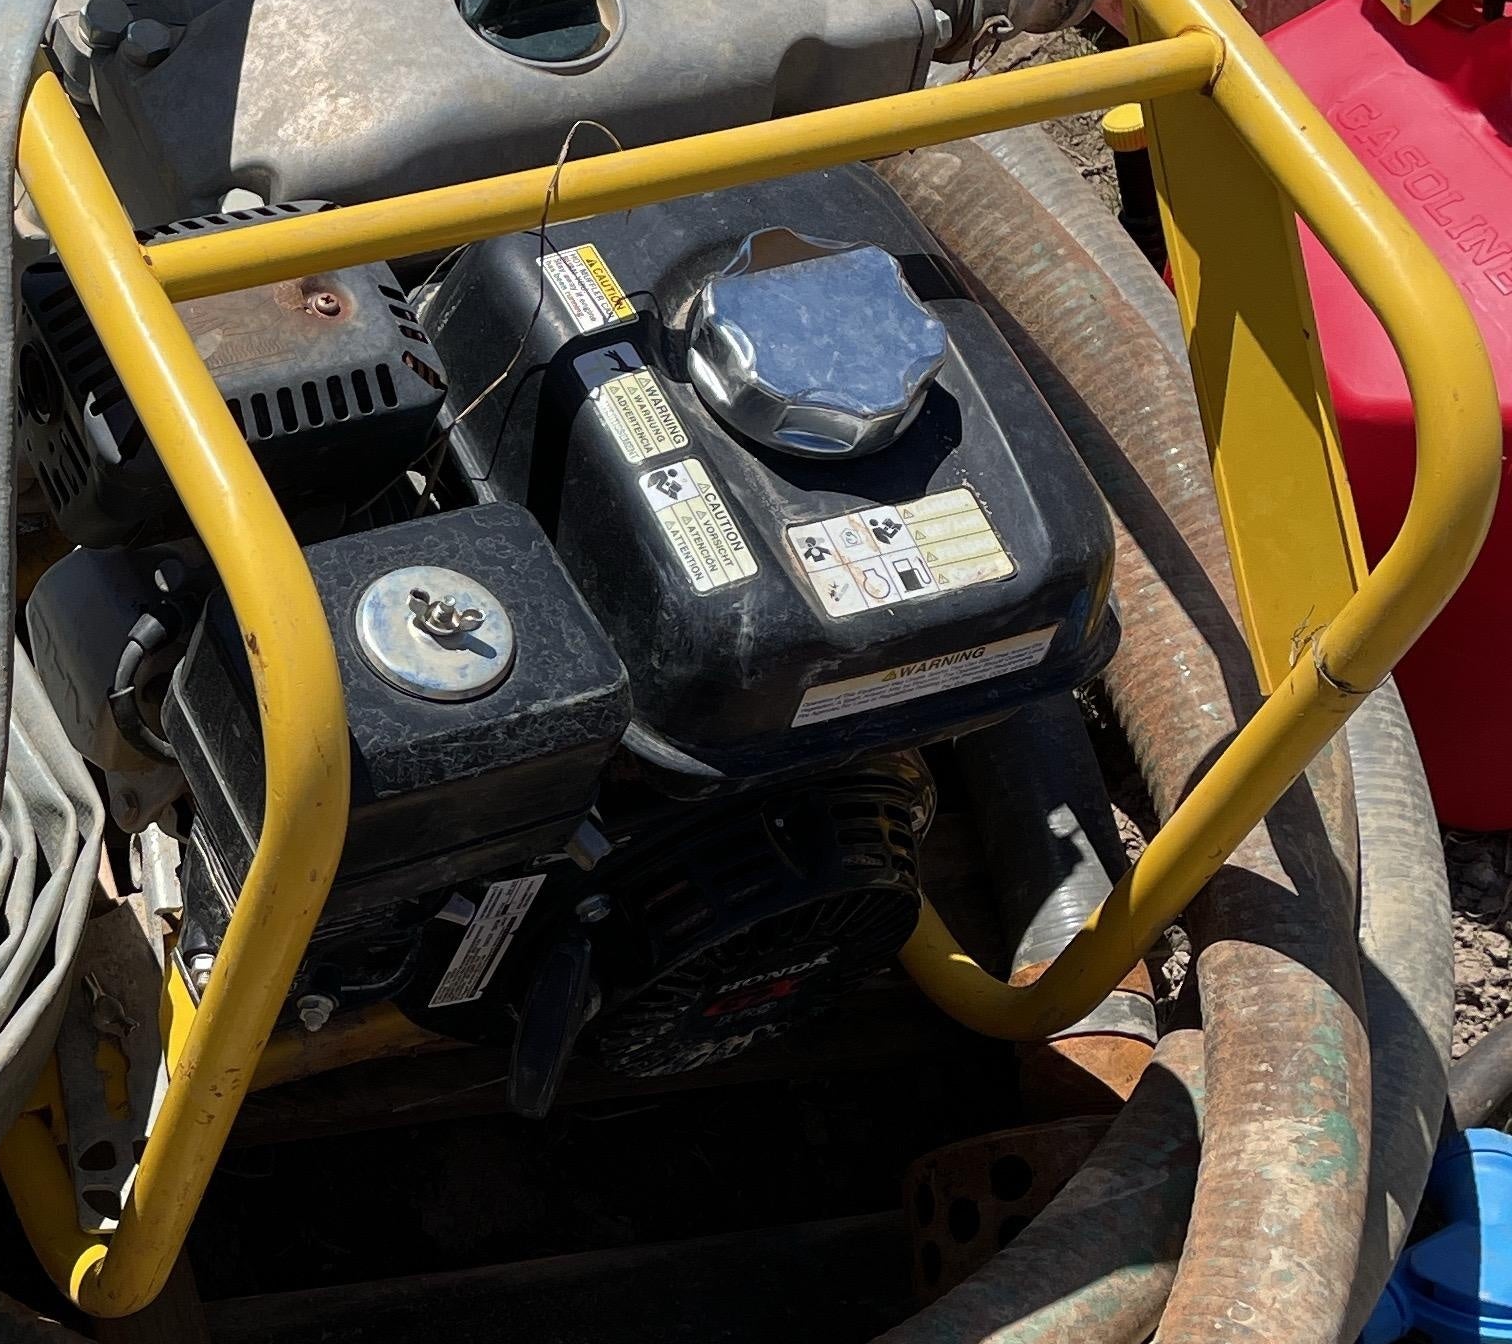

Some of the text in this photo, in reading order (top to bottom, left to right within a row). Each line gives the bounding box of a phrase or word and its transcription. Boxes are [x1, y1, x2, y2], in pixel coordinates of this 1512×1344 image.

[1337, 102, 1512, 297] GASOLINE
[580, 269, 605, 301] MUFFLER
[593, 267, 626, 311] CAUTION
[616, 394, 653, 454] ADVERTENCIA
[634, 394, 666, 443] WARNUNG
[645, 386, 685, 445] WARNING
[703, 520, 734, 568] VORSICHT
[704, 492, 744, 552] CAUTION
[671, 528, 704, 581] ATTENTION
[687, 525, 719, 573] ATENCIÓN
[899, 646, 986, 679] WARNING
